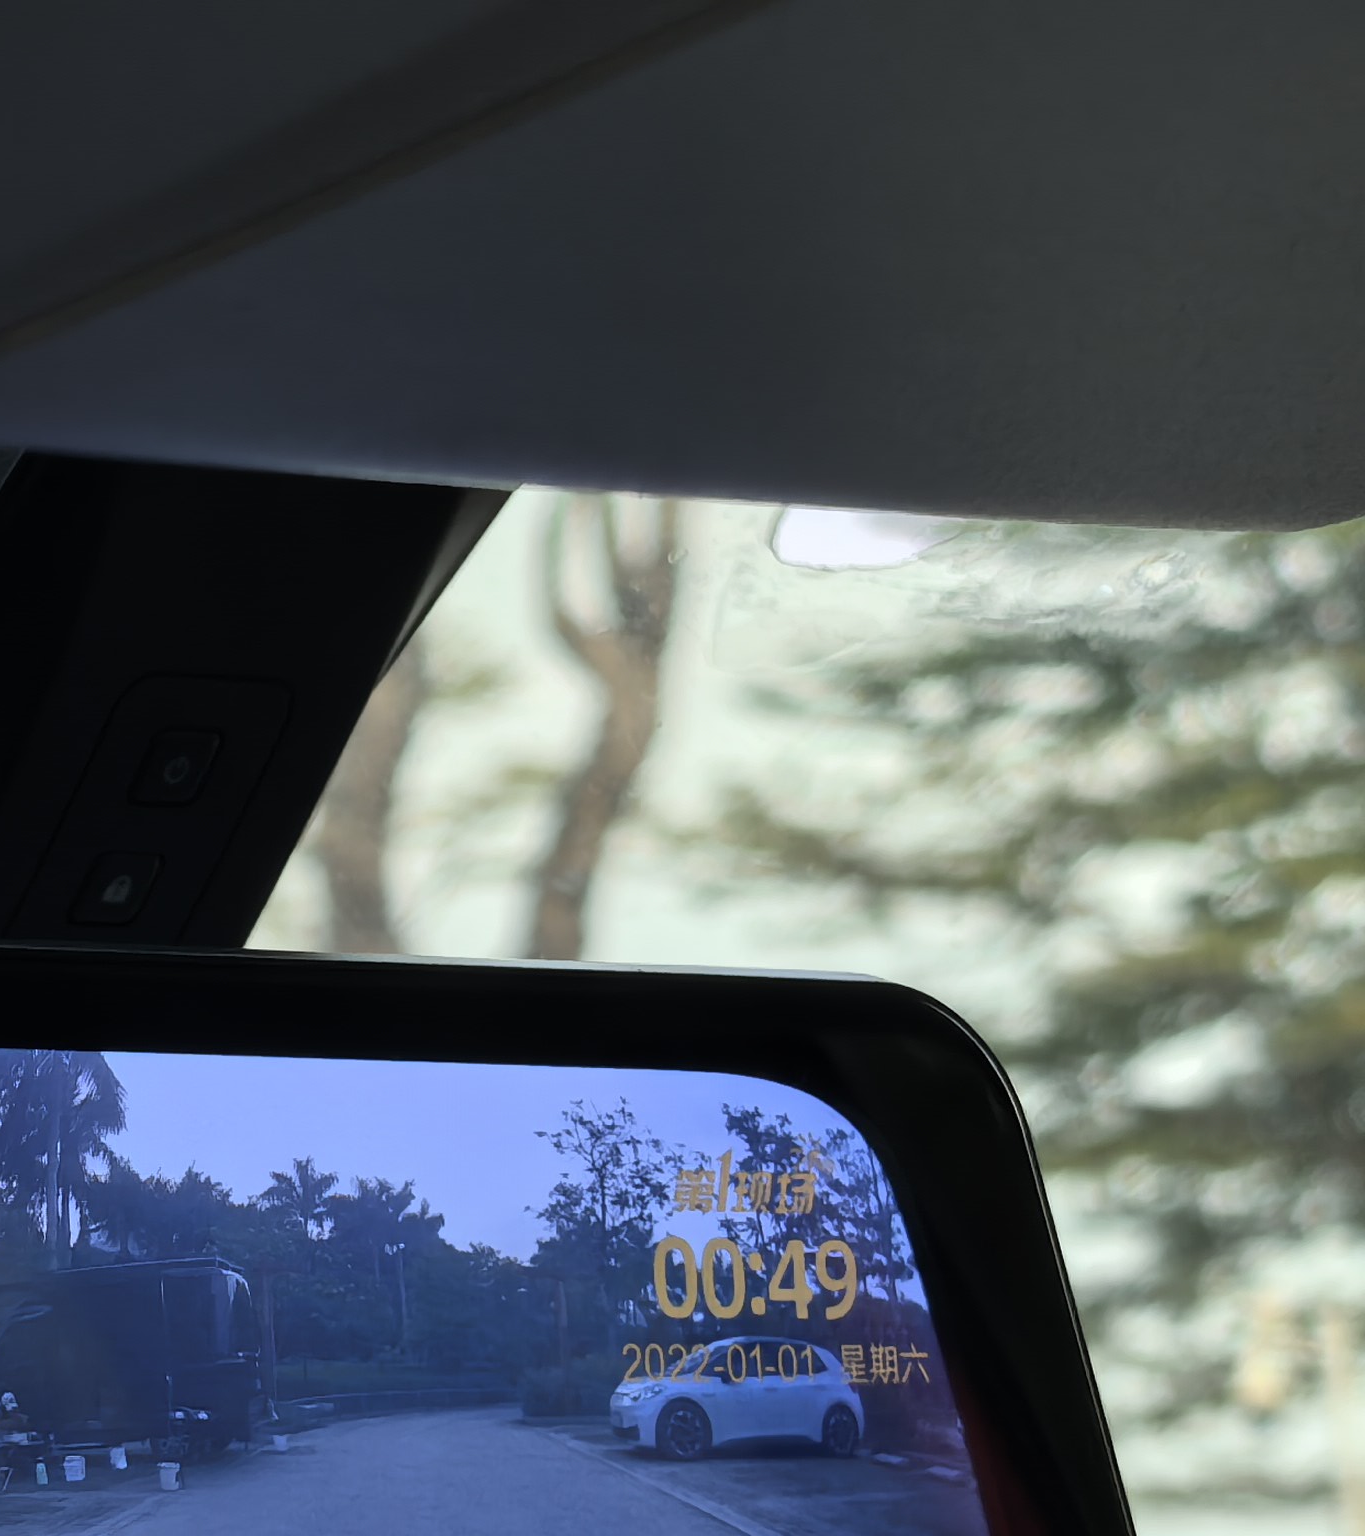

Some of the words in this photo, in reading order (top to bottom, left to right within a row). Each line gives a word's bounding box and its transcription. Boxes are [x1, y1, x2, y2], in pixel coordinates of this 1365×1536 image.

[653, 1234, 858, 1320] 00:49
[621, 1342, 817, 1384] 2022-01-01
[840, 1342, 931, 1384] 星期六
